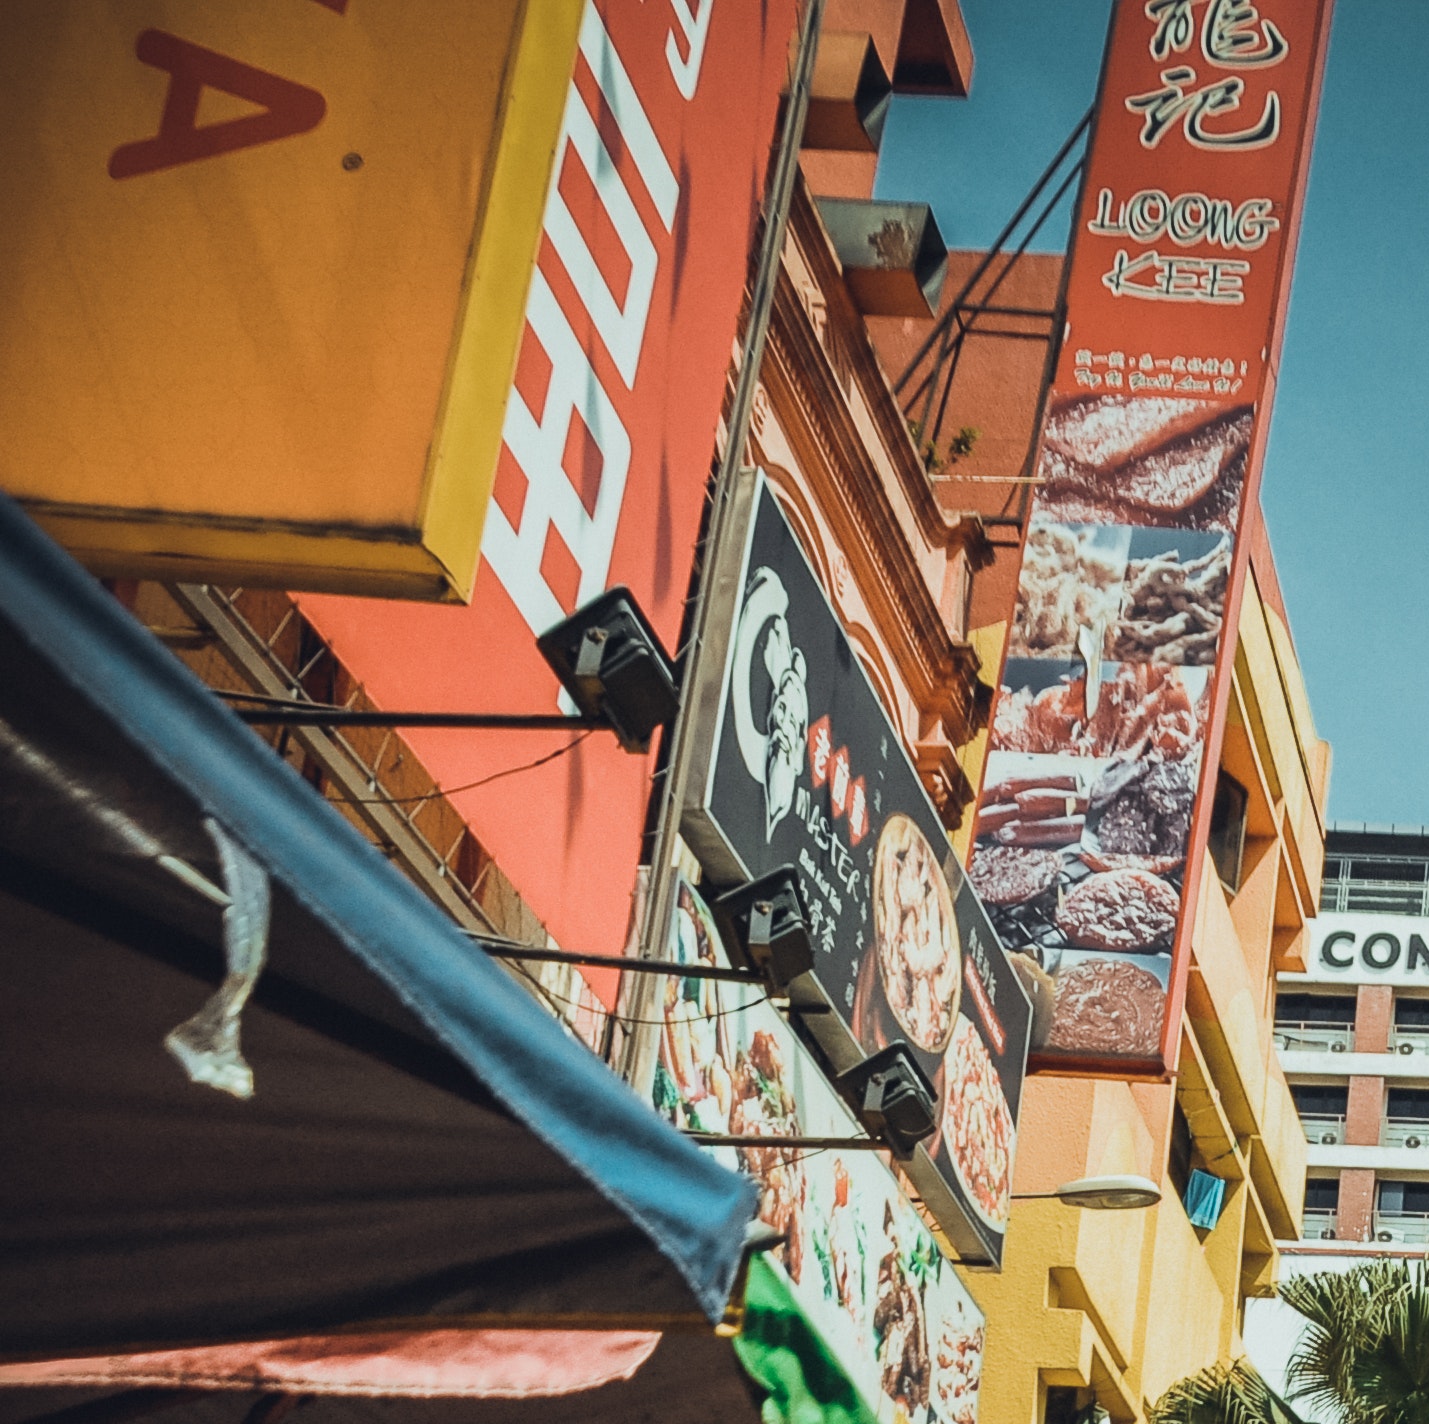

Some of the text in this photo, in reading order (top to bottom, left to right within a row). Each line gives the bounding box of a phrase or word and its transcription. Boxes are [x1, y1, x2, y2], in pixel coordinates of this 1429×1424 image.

[1088, 188, 1280, 252] LOONG
[1102, 250, 1251, 304] KEE
[796, 786, 859, 903] MASTER
